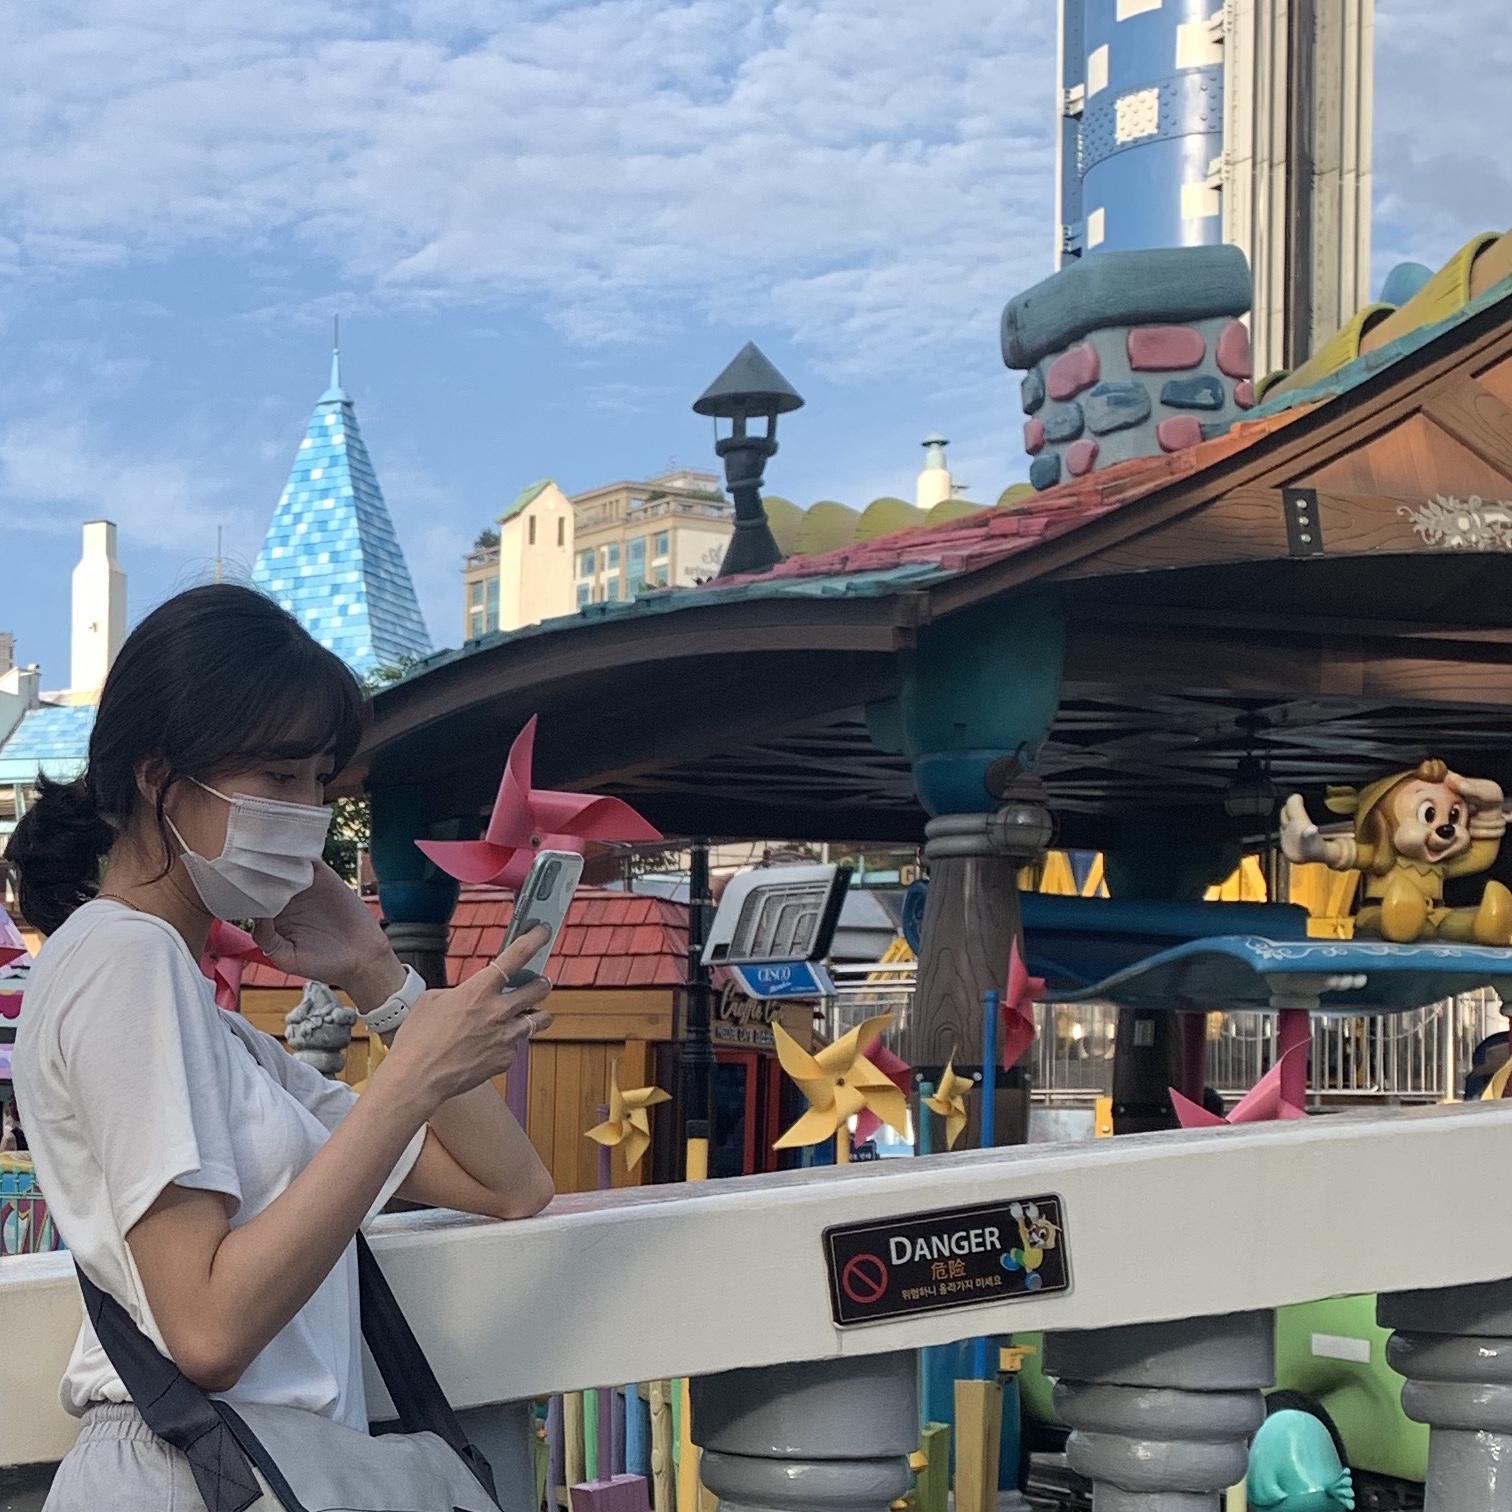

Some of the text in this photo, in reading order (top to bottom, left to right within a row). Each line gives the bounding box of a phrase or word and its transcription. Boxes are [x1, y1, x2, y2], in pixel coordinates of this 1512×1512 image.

[889, 1227, 1002, 1266] DANGER
[930, 1258, 967, 1281] 危险
[901, 1285, 937, 1301] 위험하니
[938, 1279, 973, 1296] 올라가지
